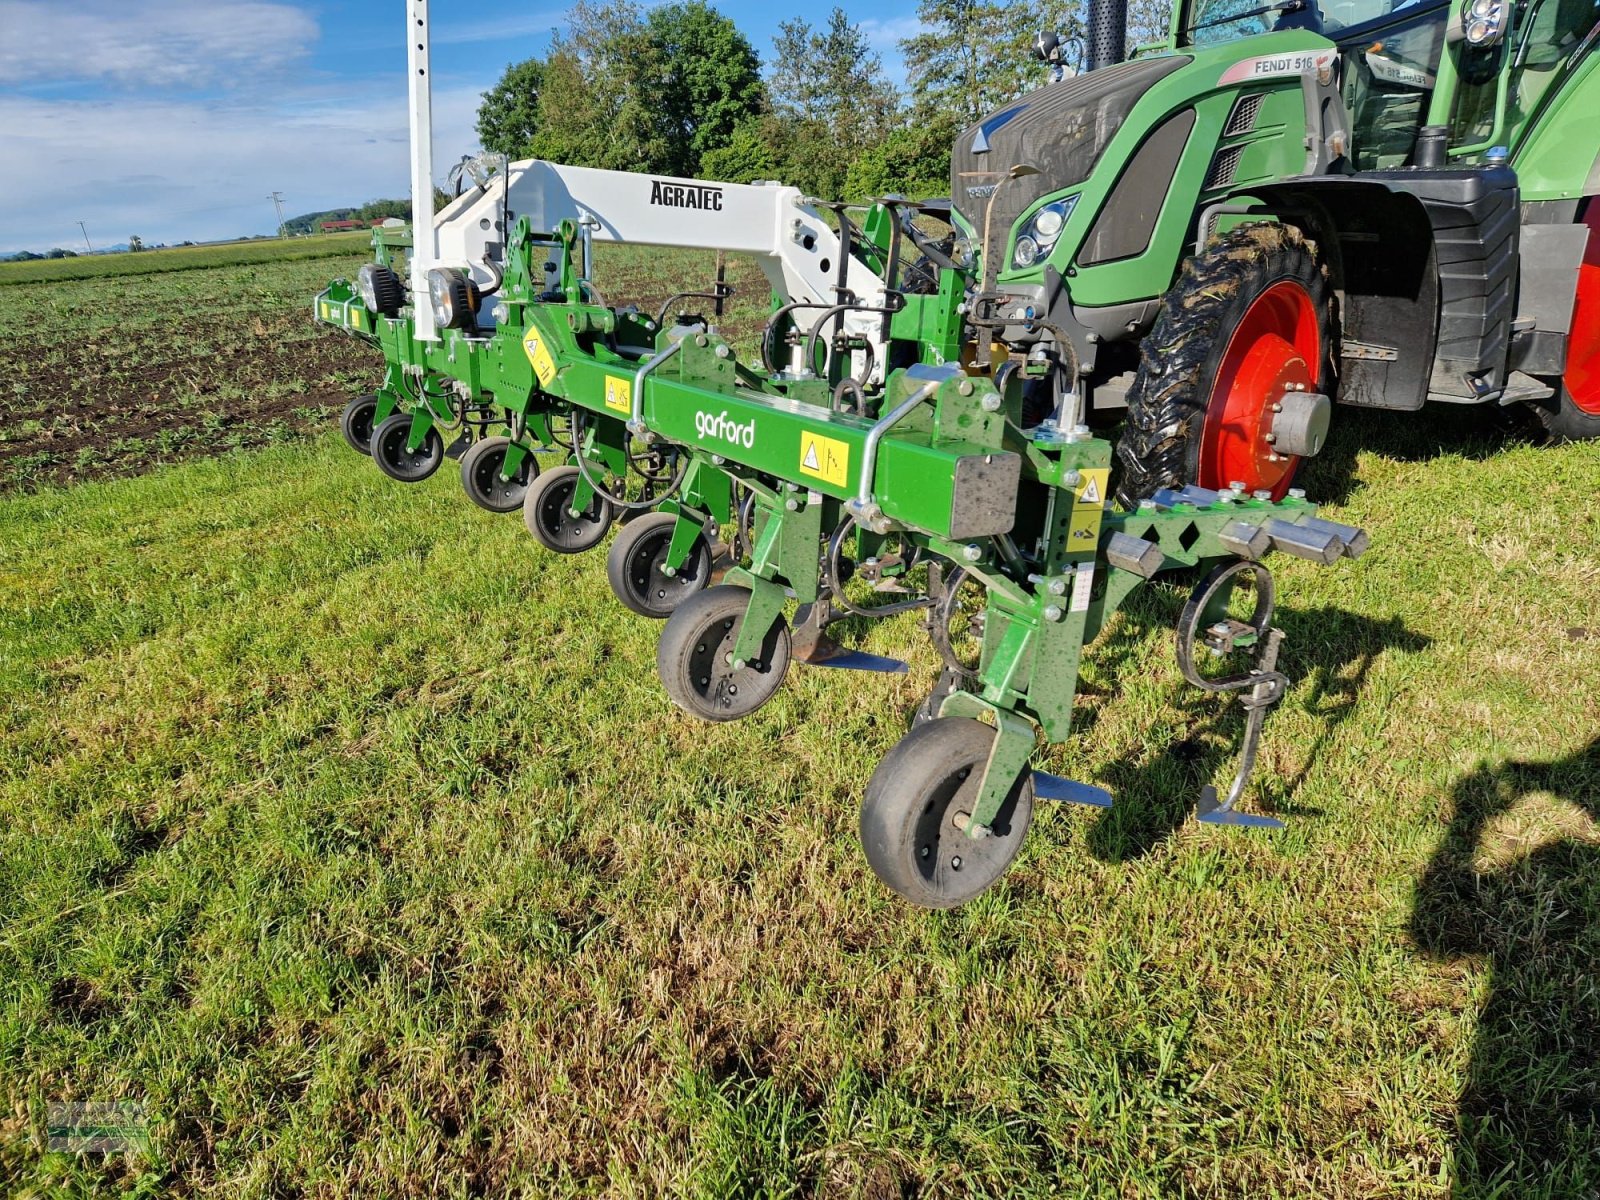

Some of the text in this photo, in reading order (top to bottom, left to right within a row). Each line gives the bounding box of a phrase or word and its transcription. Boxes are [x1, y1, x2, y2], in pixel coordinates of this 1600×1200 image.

[1255, 59, 1292, 73] FENDT
[1295, 57, 1313, 69] 516
[650, 180, 723, 211] AGRATEC
[695, 410, 755, 449] garford
